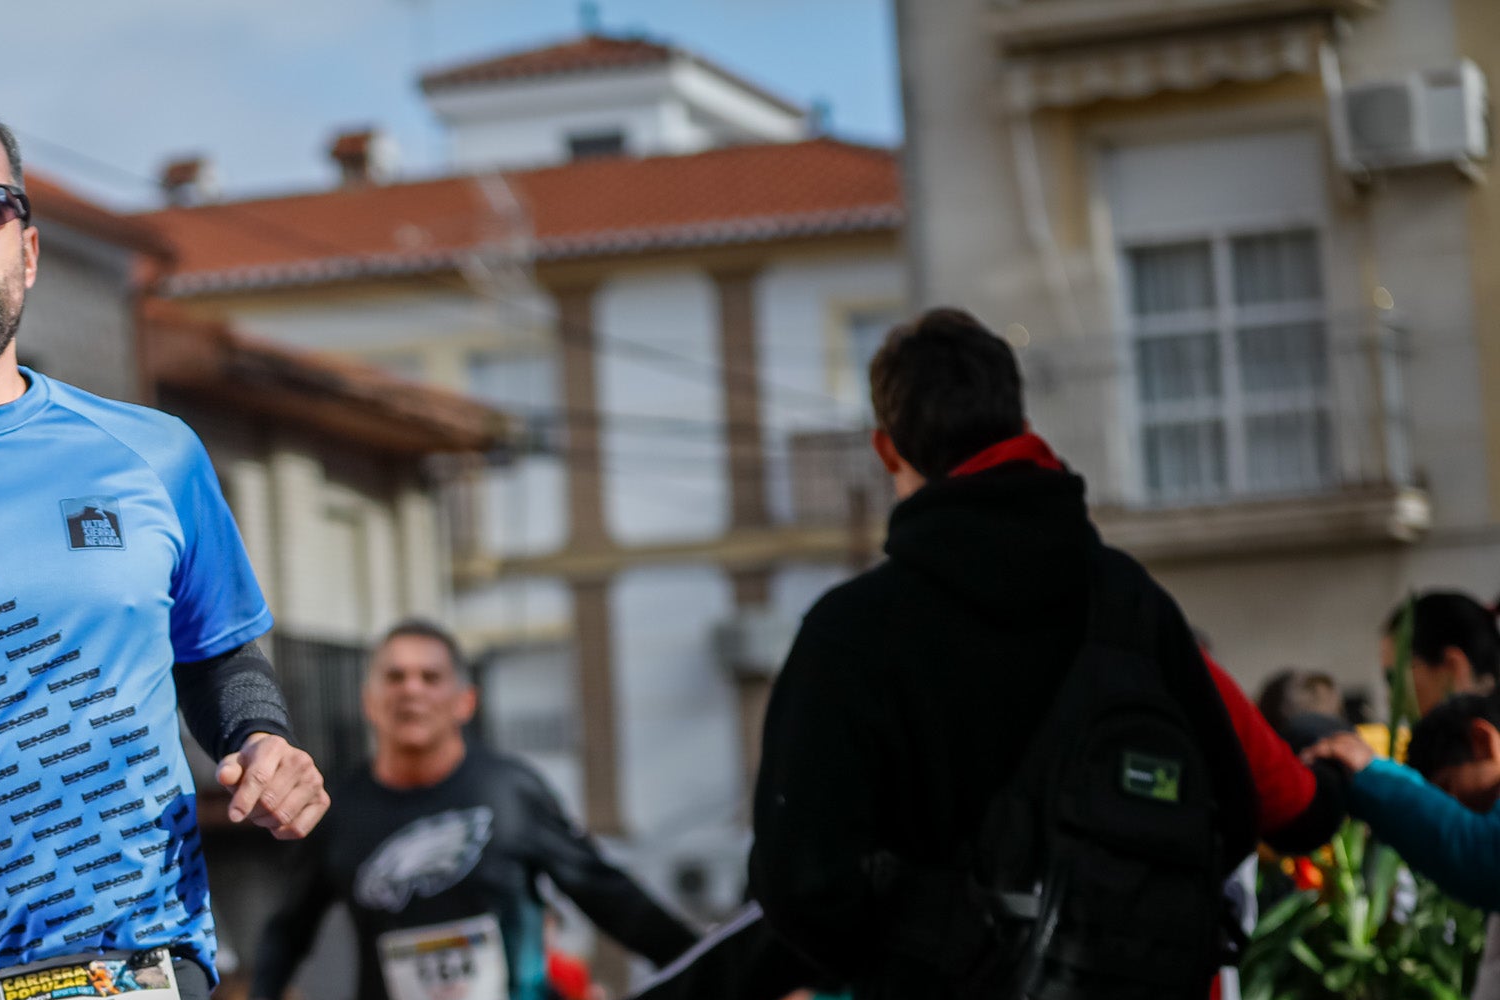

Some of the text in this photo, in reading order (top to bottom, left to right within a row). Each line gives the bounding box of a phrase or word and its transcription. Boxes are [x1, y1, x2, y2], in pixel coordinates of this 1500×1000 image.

[81, 519, 112, 529] ULTRA
[83, 528, 117, 537] SIERRA
[84, 536, 122, 546] NEVADA
[3, 966, 87, 992] CARRERA
